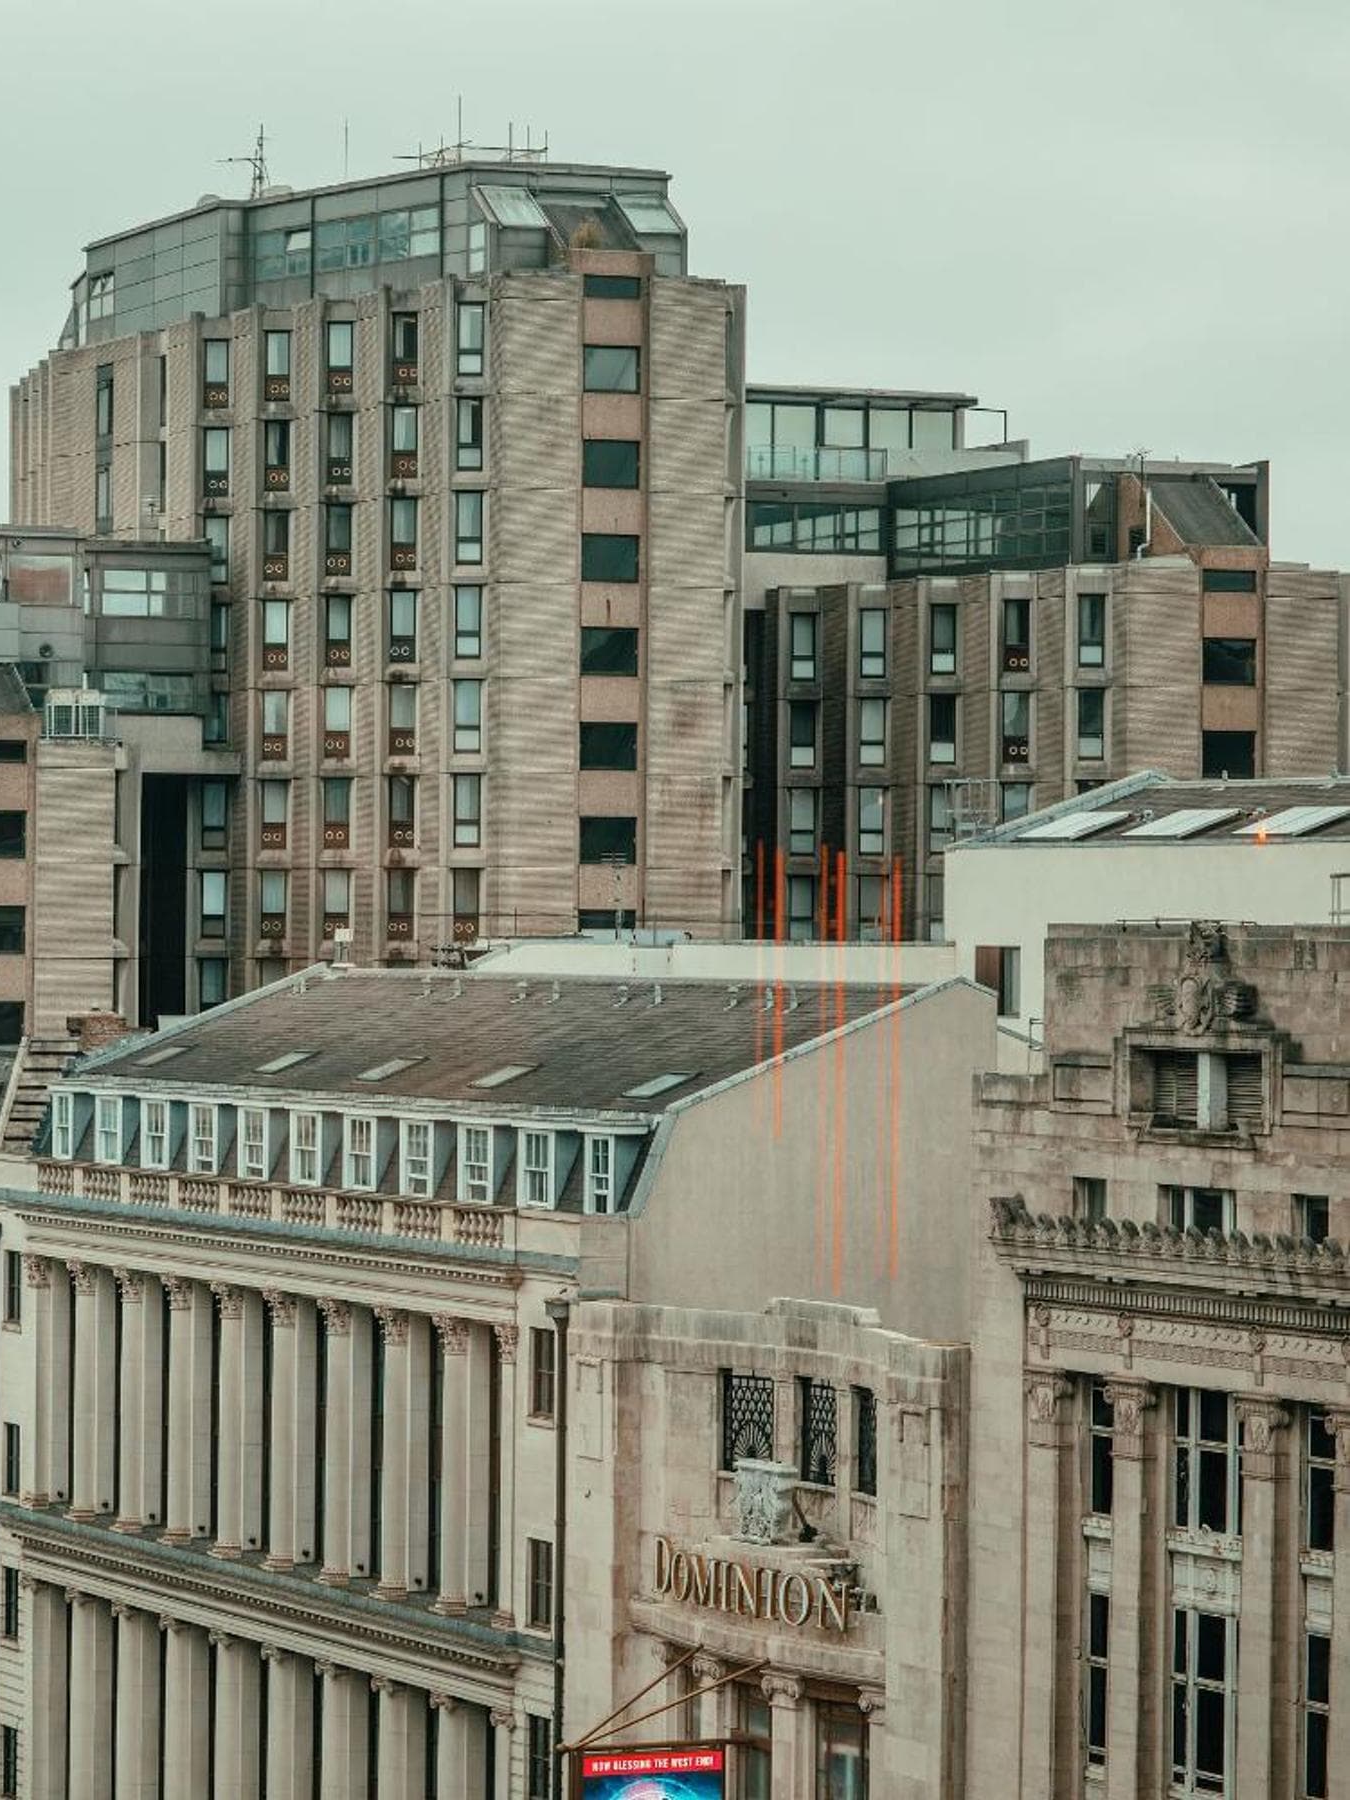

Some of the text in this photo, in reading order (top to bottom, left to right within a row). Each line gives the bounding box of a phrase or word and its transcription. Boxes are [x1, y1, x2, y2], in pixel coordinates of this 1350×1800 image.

[652, 1535, 849, 1632] DOMINION
[654, 1758, 669, 1769] THE
[671, 1756, 693, 1768] WEST
